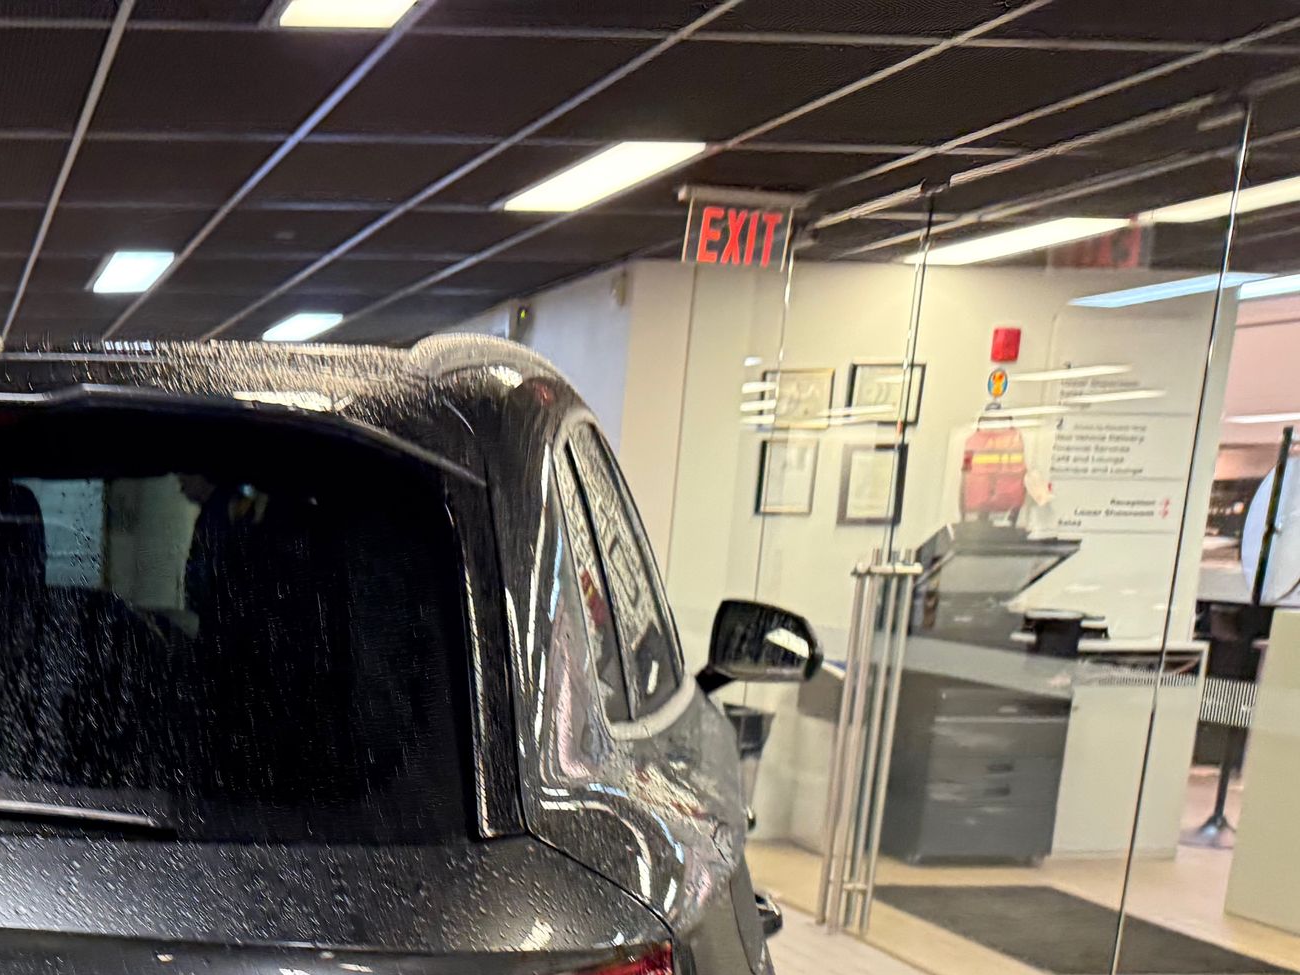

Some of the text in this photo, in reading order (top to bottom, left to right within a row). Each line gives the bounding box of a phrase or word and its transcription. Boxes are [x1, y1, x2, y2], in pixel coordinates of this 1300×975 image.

[696, 206, 783, 268] EXIT
[1108, 434, 1145, 445] Delivery
[1094, 444, 1130, 453] Services
[1073, 455, 1090, 463] and
[1091, 455, 1124, 465] Lounge
[1110, 466, 1143, 475] Lounge
[1110, 498, 1156, 507] Reception
[1074, 508, 1155, 516] Lower Showroom
[1057, 518, 1082, 527] Sales
